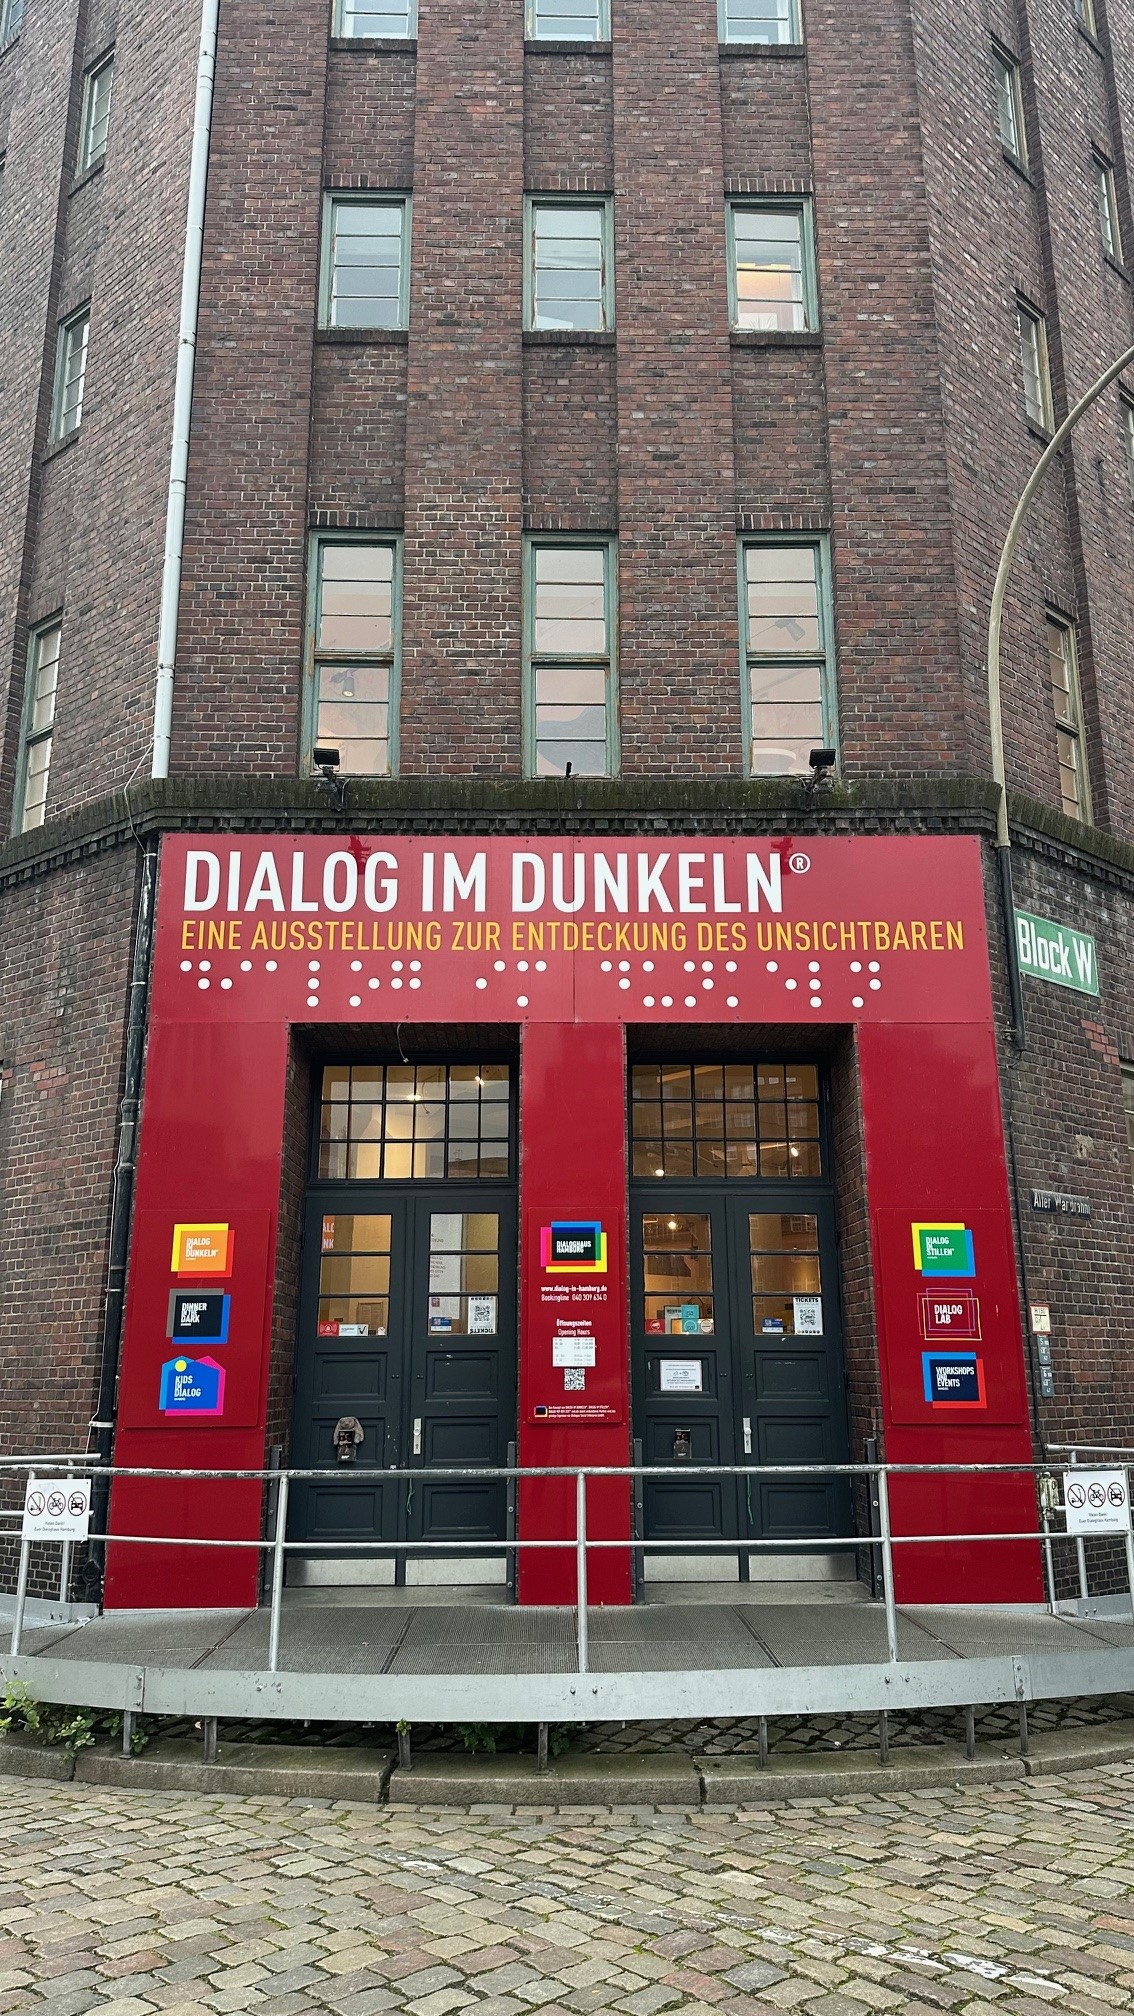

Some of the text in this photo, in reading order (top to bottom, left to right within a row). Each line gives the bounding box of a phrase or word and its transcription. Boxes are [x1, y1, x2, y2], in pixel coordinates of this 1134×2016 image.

[183, 850, 399, 913] DIALOG
[422, 852, 487, 913] IM
[181, 920, 964, 952] EINE AUSSTELLUNG ZUR ENTDECKUNG DES UNSICHTBAREN
[1017, 916, 1092, 985] Block W
[187, 1237, 211, 1246] DIALOG
[556, 1240, 592, 1248] DIALOGHAUS
[925, 1236, 950, 1245] DIALOG
[182, 1302, 208, 1311] DINNER
[934, 1304, 963, 1315] DIALOG
[181, 1314, 201, 1323] DARK
[935, 1314, 952, 1324] LAB
[935, 1366, 975, 1376] WORKSHOPS
[175, 1375, 194, 1385] KIDS
[937, 1378, 961, 1387] EVENTS
[174, 1388, 202, 1398] DIALOG
